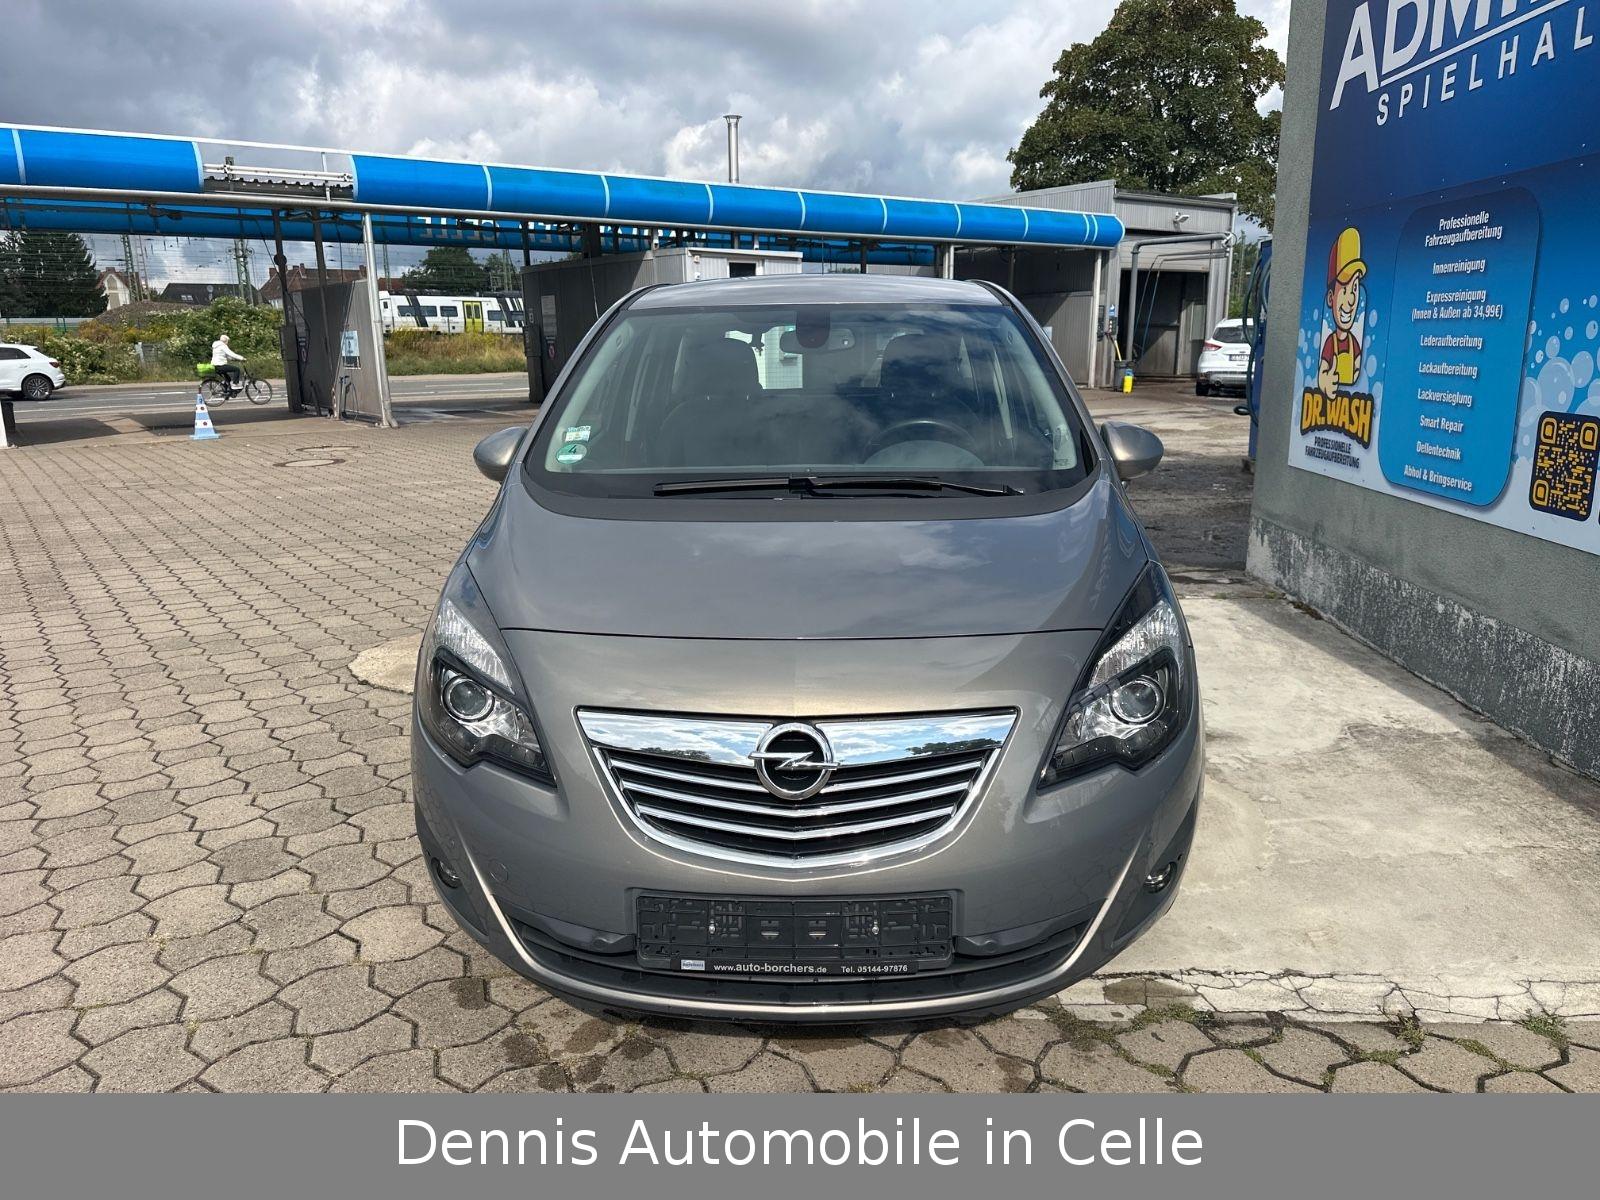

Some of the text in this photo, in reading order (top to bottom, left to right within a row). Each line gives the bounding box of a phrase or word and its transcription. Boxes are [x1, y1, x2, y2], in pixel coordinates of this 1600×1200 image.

[1376, 6, 1593, 126] SPIELHAL
[1439, 211, 1490, 231] Professionelle
[1424, 225, 1503, 247] Fahrzeugaufbereitung
[1432, 257, 1486, 275] Innenreinigung
[1426, 289, 1487, 305] Expressreinigung
[1432, 308, 1438, 319] &
[1439, 306, 1461, 319] Außen
[1462, 305, 1472, 318] ab
[1473, 304, 1503, 320] 34,99€)
[1420, 334, 1483, 350] Lederaufbereitung
[1418, 361, 1478, 379] Lackaufbereitung
[1417, 388, 1473, 407] Lackversieglung
[1326, 396, 1372, 443] WASH
[1420, 414, 1464, 433] Smart Repair
[567, 444, 577, 454] 4
[1314, 436, 1352, 454] PROFESSIONELLE
[1416, 440, 1461, 460] Dellentechnik
[1404, 464, 1473, 491] Abhol & Bringservice
[713, 963, 828, 974] www.auto-borchers.de
[841, 965, 855, 973] Tel.
[857, 964, 908, 973] 05144-97876
